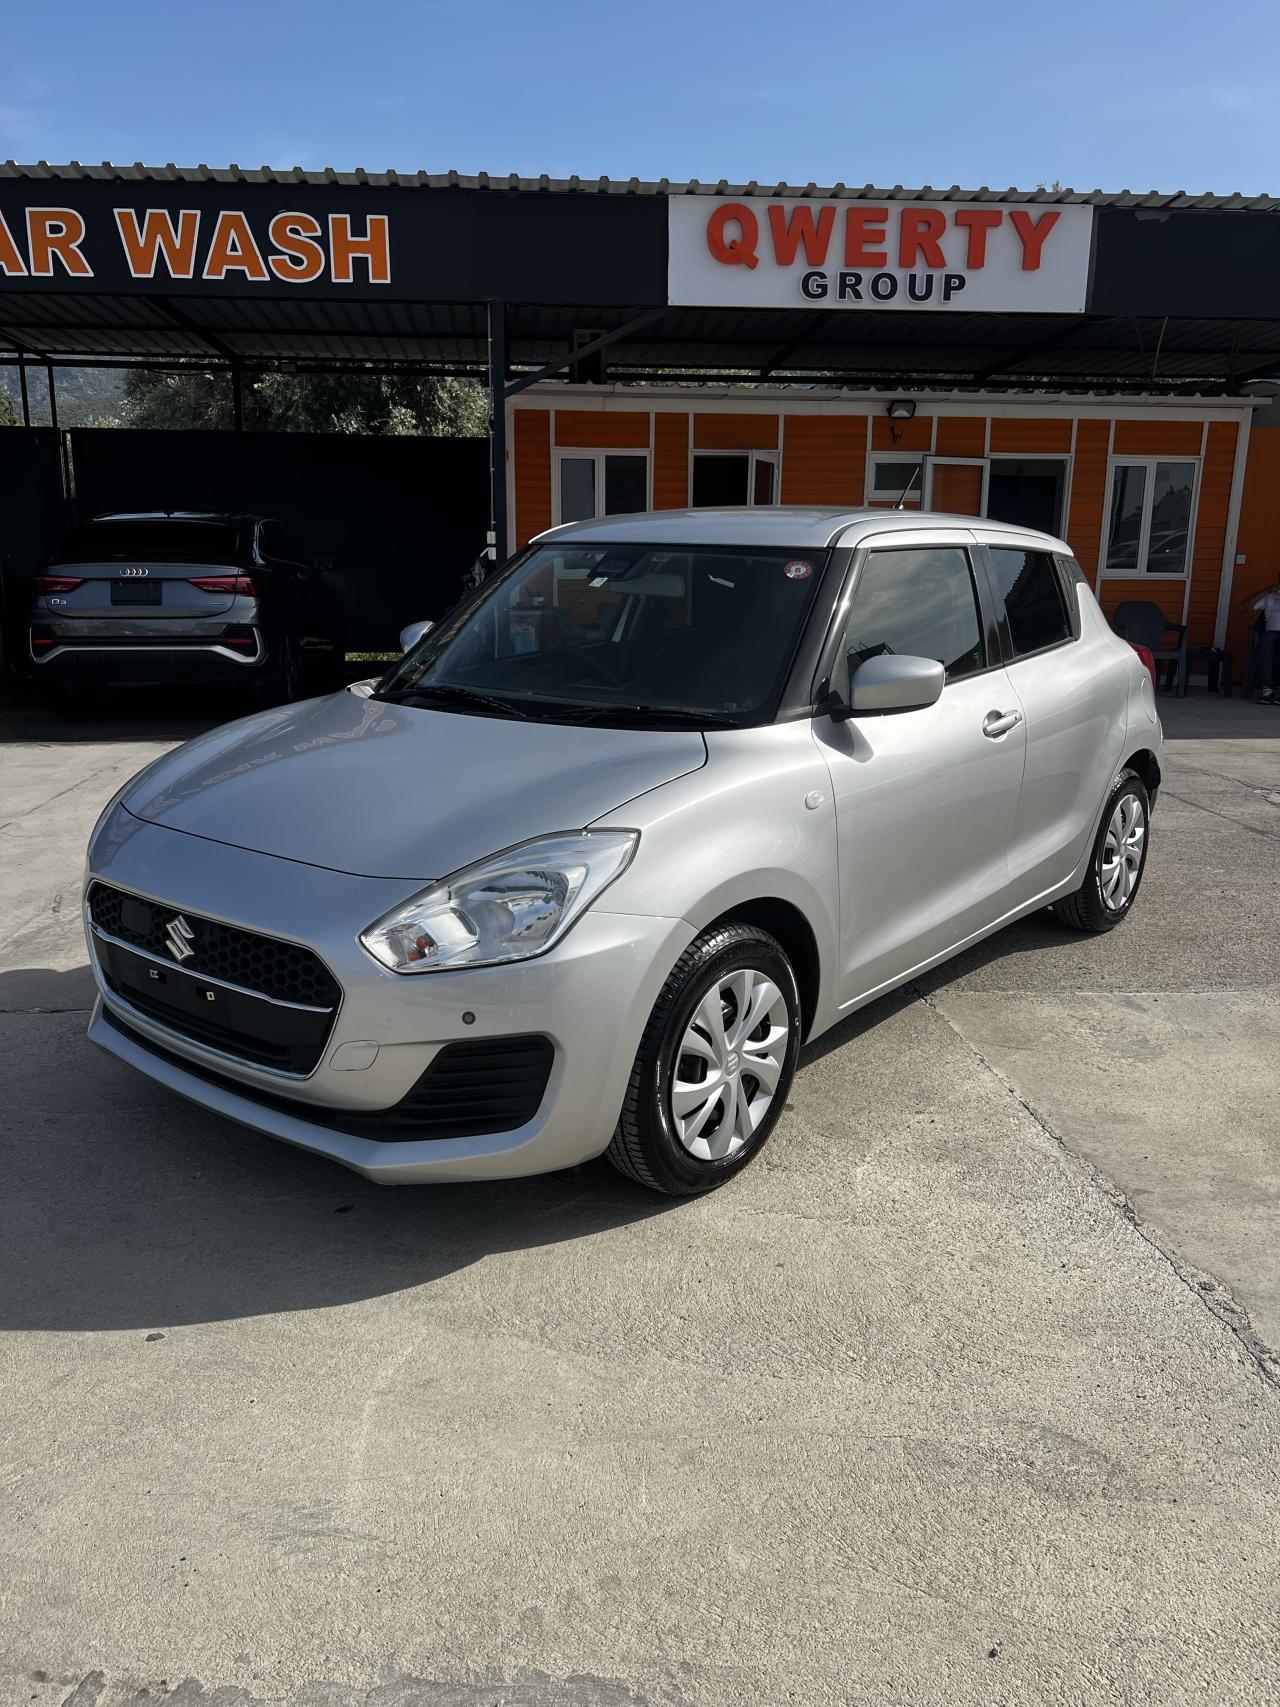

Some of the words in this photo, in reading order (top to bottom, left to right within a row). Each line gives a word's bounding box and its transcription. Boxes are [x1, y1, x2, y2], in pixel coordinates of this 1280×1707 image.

[113, 208, 391, 284] WASH
[706, 203, 1062, 270] QWERTY
[800, 270, 967, 303] GROUP
